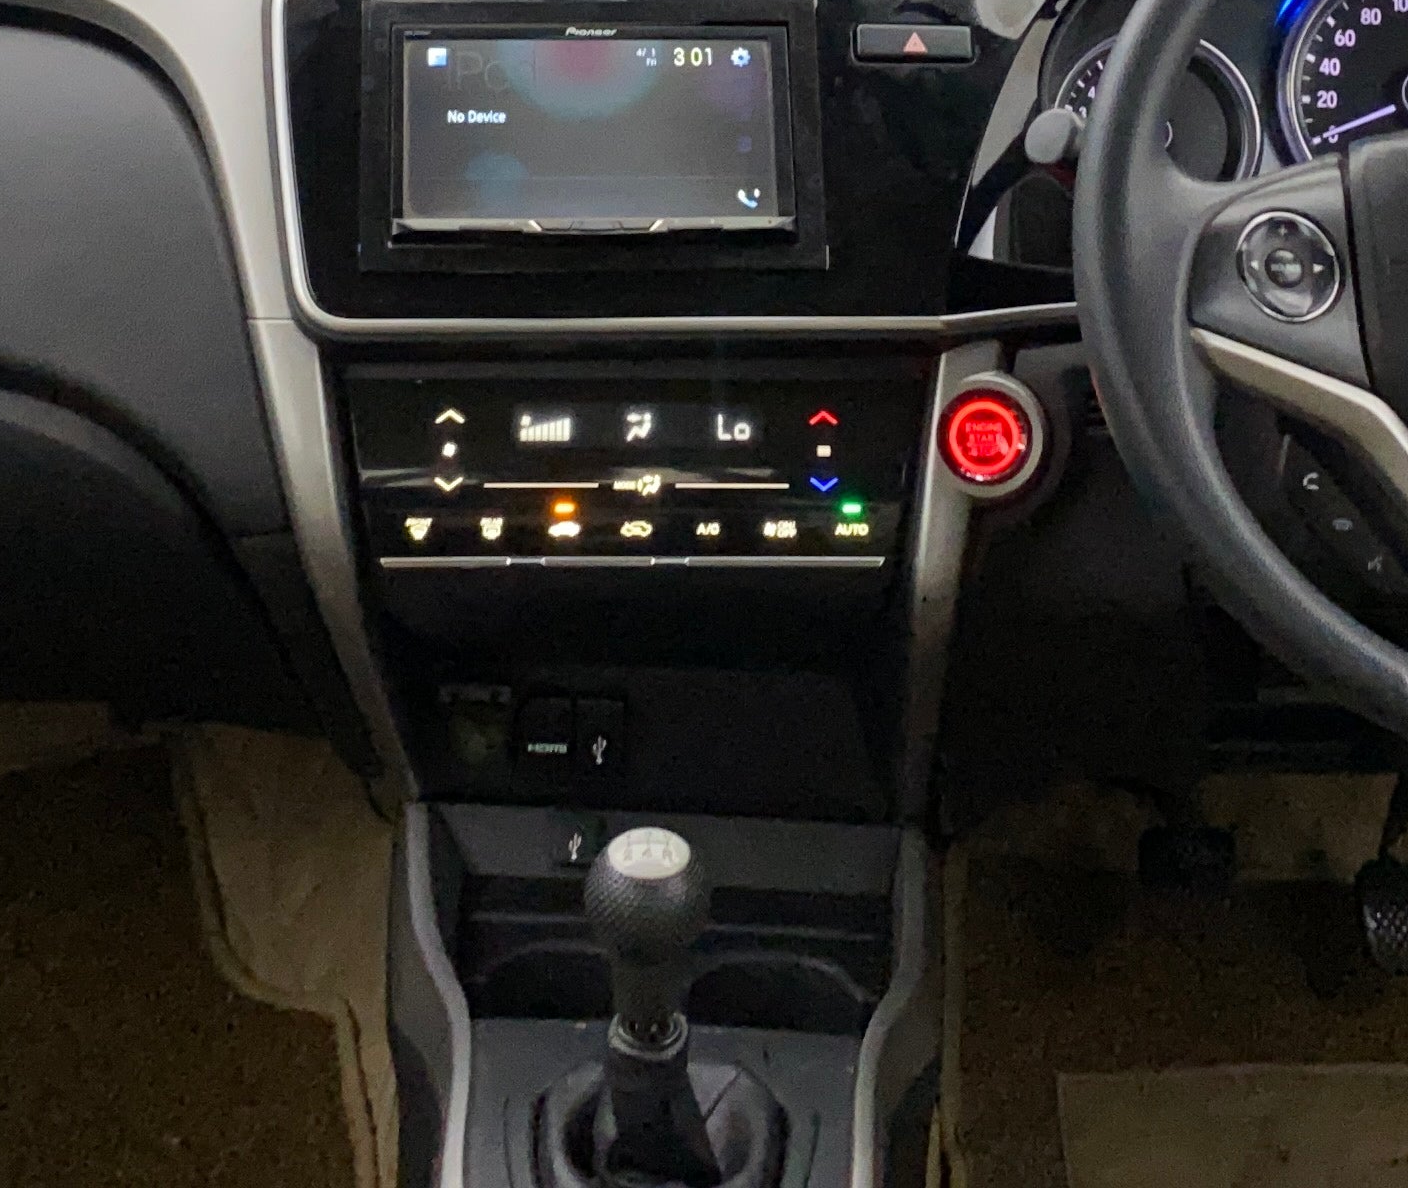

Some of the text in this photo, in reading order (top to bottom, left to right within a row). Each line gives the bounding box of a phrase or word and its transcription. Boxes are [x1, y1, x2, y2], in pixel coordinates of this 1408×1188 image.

[1360, 8, 1382, 26] 80
[565, 26, 618, 37] Pioneer
[1334, 29, 1356, 48] 60
[1319, 57, 1341, 77] 40
[1316, 90, 1338, 109] 20
[447, 109, 507, 124] No Device
[717, 413, 752, 441] Lo
[834, 522, 869, 536] AUTO
